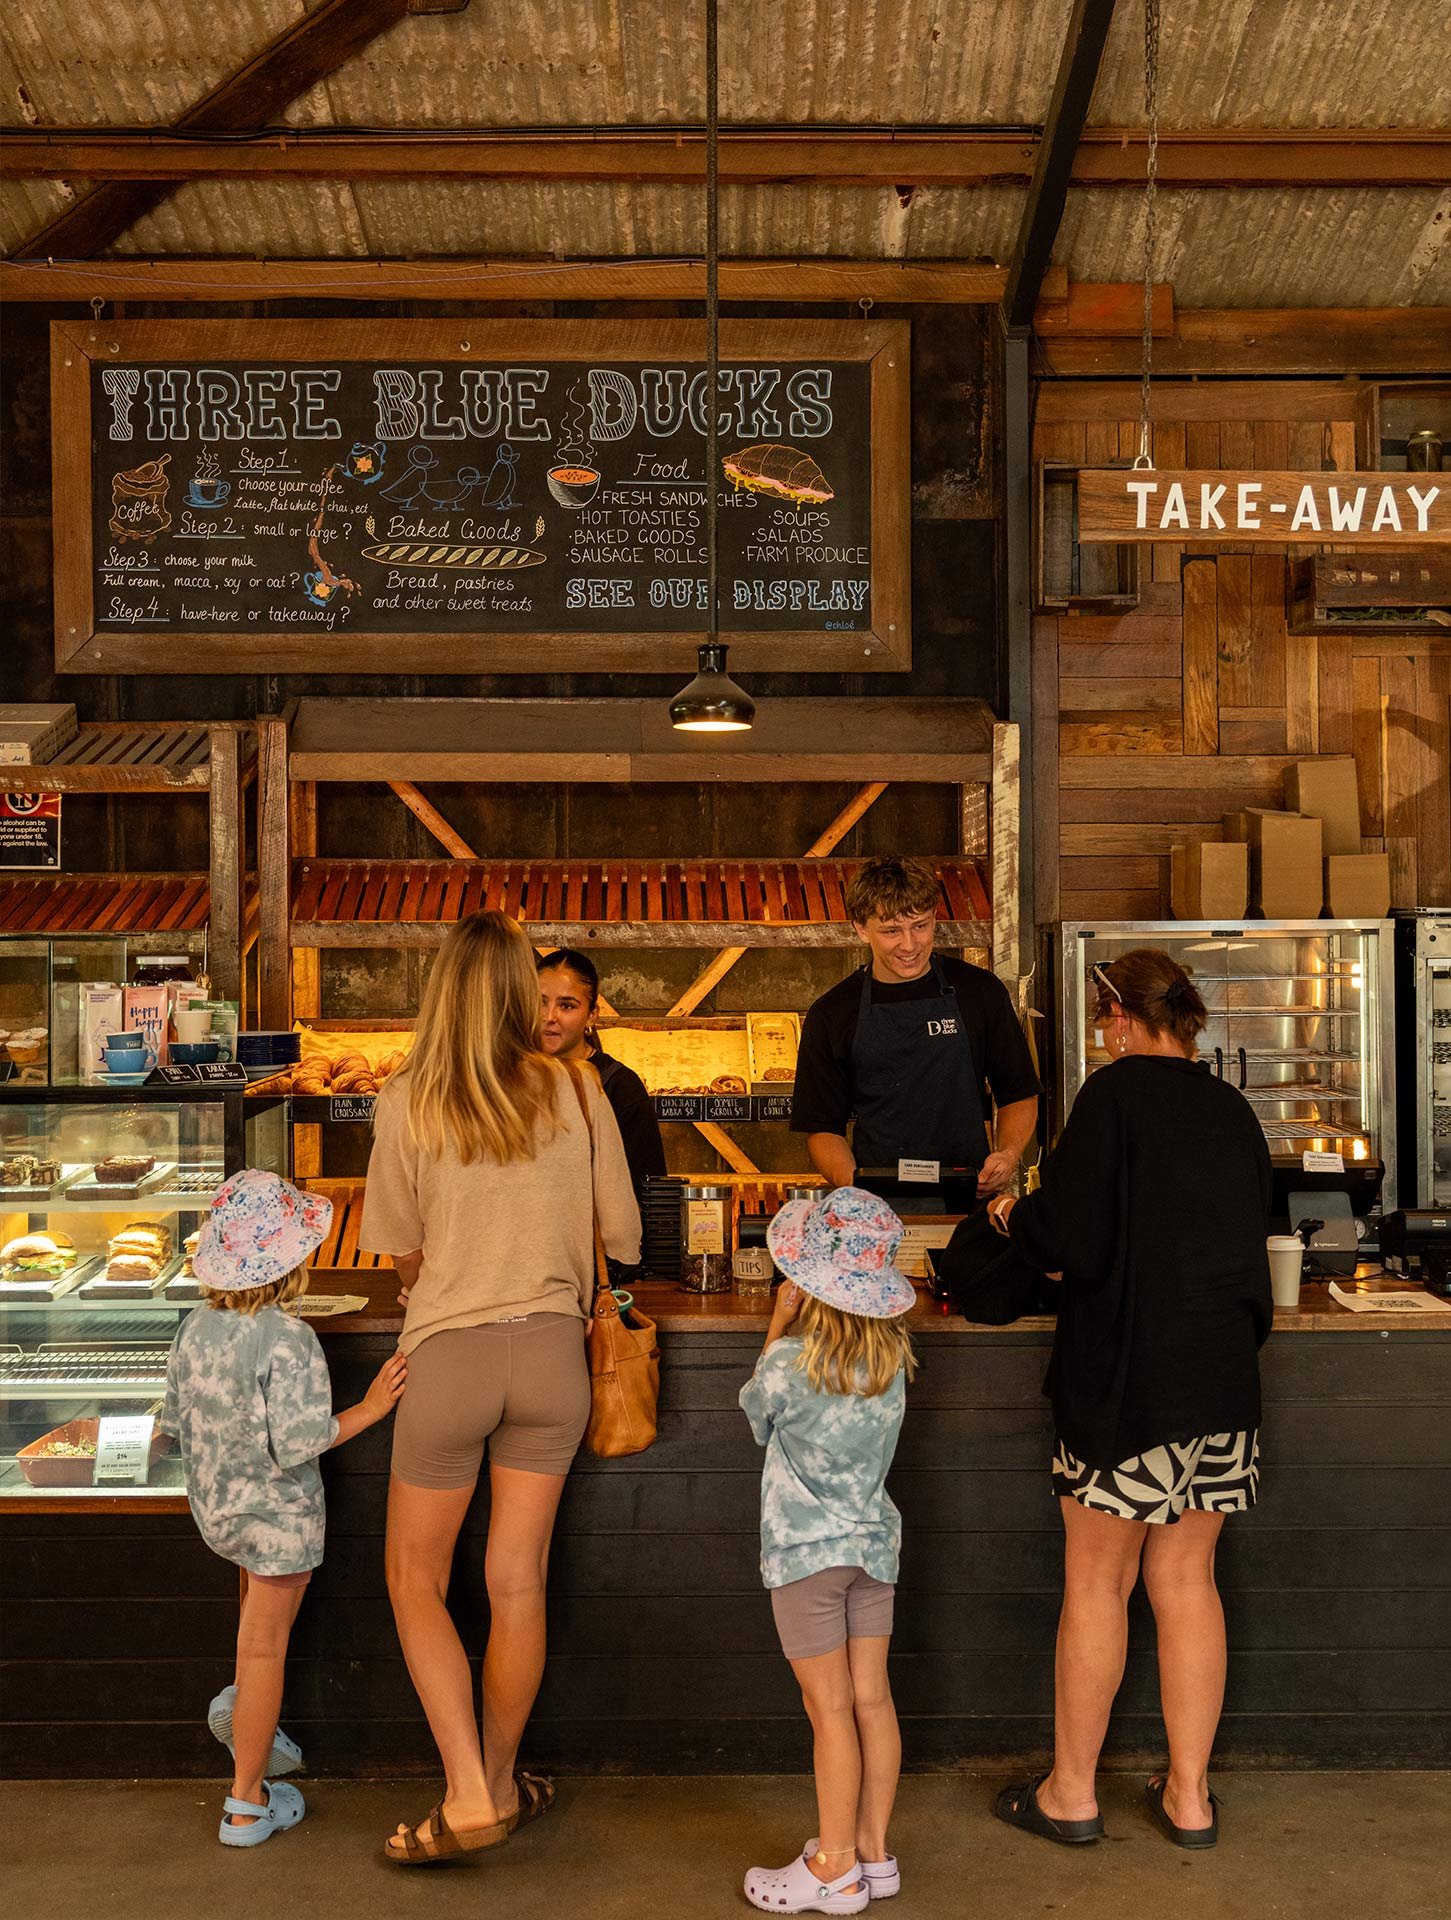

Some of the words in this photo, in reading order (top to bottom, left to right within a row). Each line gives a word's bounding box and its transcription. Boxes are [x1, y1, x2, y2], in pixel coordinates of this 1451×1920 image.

[102, 369, 342, 441] THREE
[372, 369, 551, 441] BLUE
[586, 369, 834, 440] DUCKS
[238, 447, 274, 476] Step
[278, 480, 307, 496] your
[309, 477, 344, 495] coffee
[267, 497, 288, 513] flat
[602, 490, 652, 505] FRESH
[660, 490, 758, 508] SANDWCHES
[1126, 482, 1440, 532] TAKE-AWAY
[117, 501, 160, 522] Coffee
[581, 510, 613, 525] HOT
[618, 509, 700, 528] TOASTIES
[773, 509, 830, 527] SOUPS
[180, 511, 218, 540] Step
[253, 522, 285, 537] small
[289, 527, 302, 537] or
[387, 515, 450, 539] Baked
[460, 518, 522, 541] Goods
[574, 529, 629, 545] BAKED
[637, 529, 696, 546] GOODS
[756, 528, 824, 544] SALADS
[103, 546, 135, 571] Step
[164, 554, 200, 568] choose
[204, 558, 228, 570] your
[231, 554, 257, 567] milk
[570, 547, 645, 564] SAUSAGE
[655, 547, 709, 564] ROLLS
[746, 545, 789, 563] FARM
[795, 546, 870, 565] PRODUCE
[103, 574, 124, 587] Full
[223, 577, 241, 594] soy
[249, 577, 263, 588] or
[454, 575, 515, 595] pastries
[372, 593, 400, 609] and
[404, 594, 444, 610] other
[447, 598, 487, 611] sweet
[490, 597, 533, 612] treats
[565, 578, 636, 609] SEE
[733, 579, 870, 611] DISPLAY
[108, 597, 144, 625] Step
[180, 603, 241, 622] have-here
[248, 609, 262, 621] or
[130, 1006, 159, 1020] Happy
[135, 1017, 163, 1032] happy
[334, 1099, 352, 1108] PLAIN
[661, 1098, 698, 1108] CHOCOLATE
[709, 1107, 733, 1117] SCROLL
[334, 1107, 373, 1119] CROISSANT
[739, 1261, 762, 1274] TIPS
